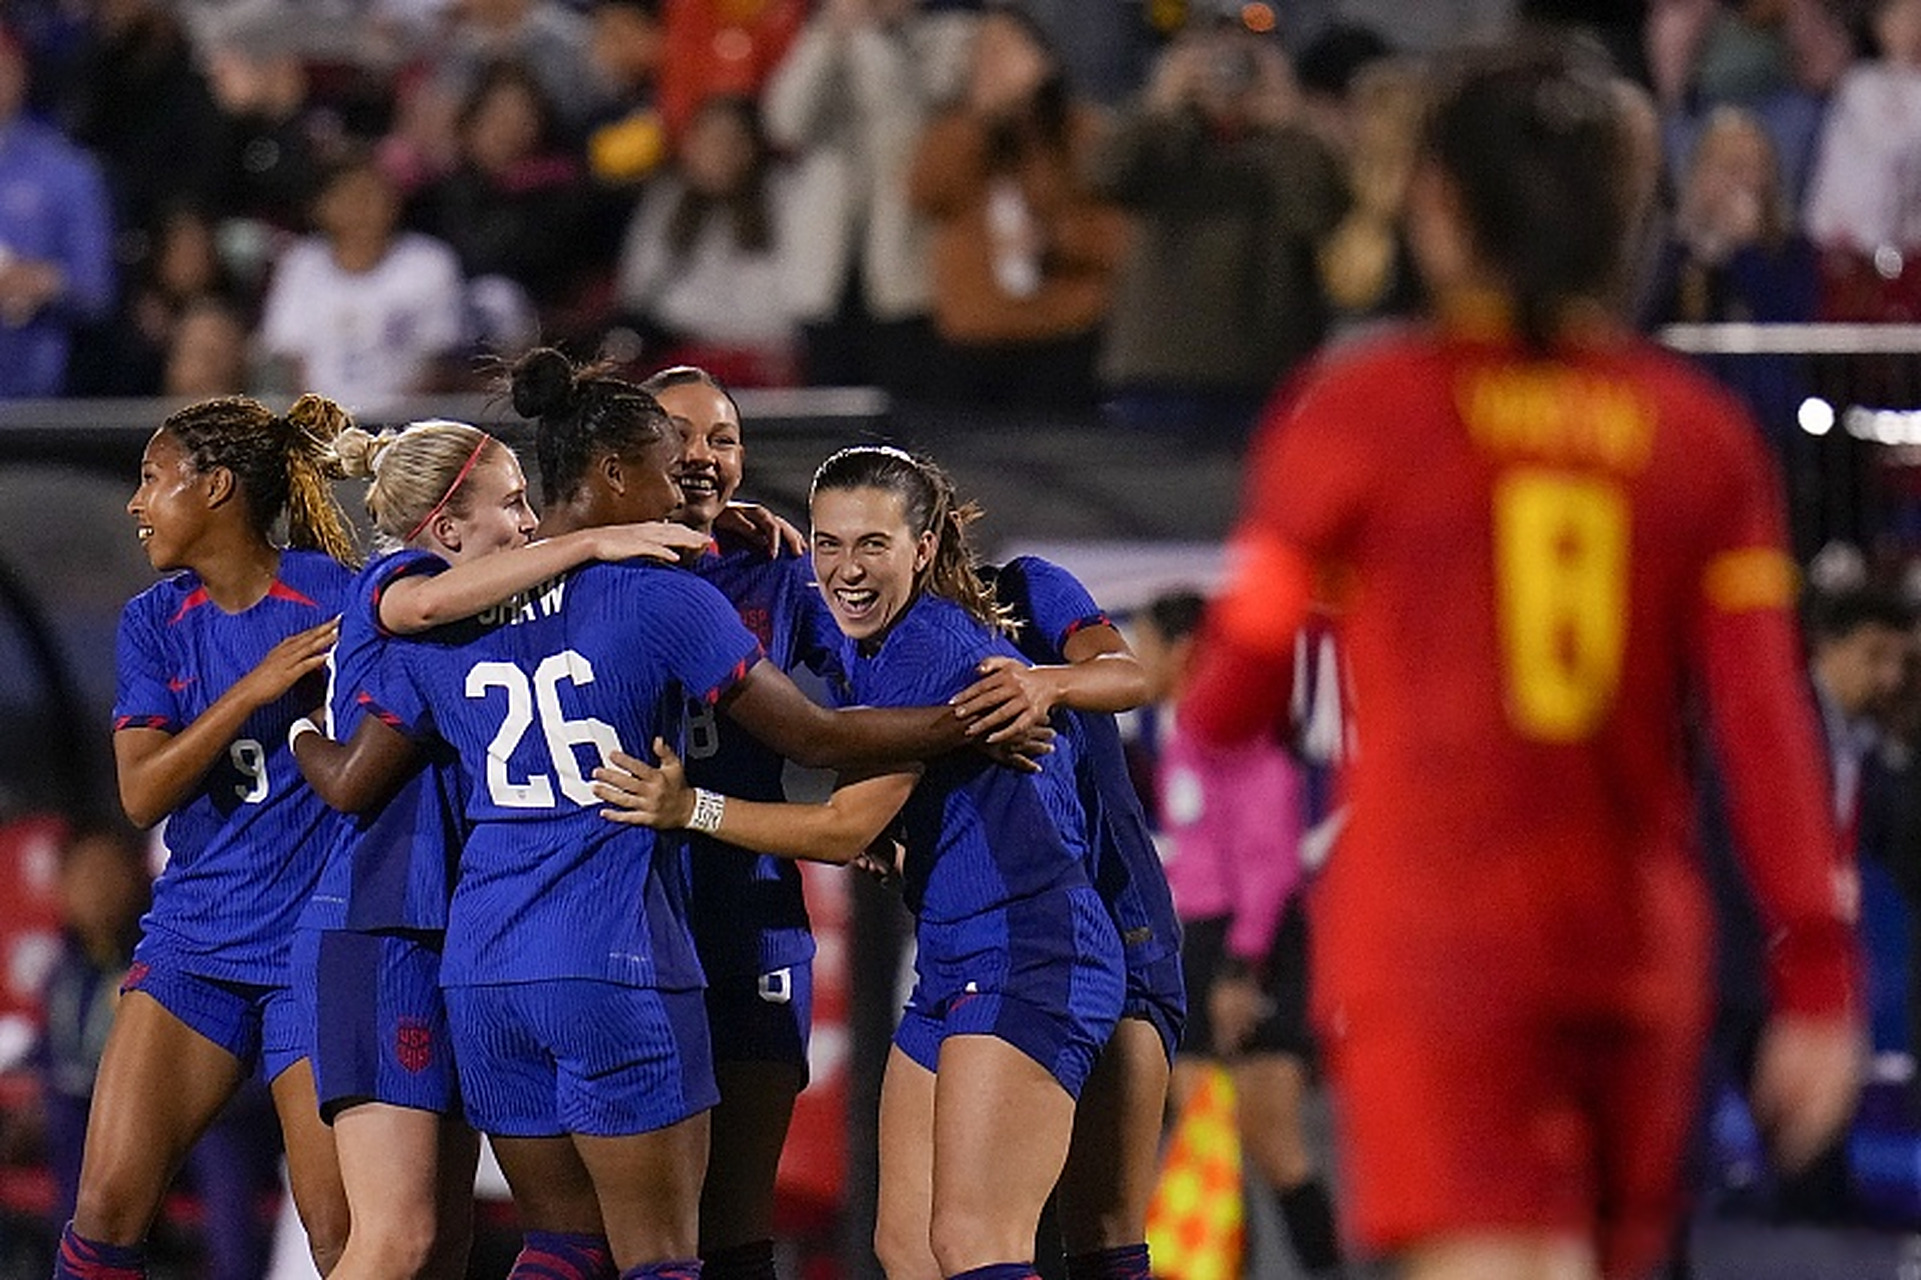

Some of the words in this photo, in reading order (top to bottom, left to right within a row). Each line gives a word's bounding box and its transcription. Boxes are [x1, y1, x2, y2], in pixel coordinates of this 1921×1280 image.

[1500, 472, 1628, 740] 8
[230, 739, 269, 804] 9
[465, 650, 633, 807] 26
